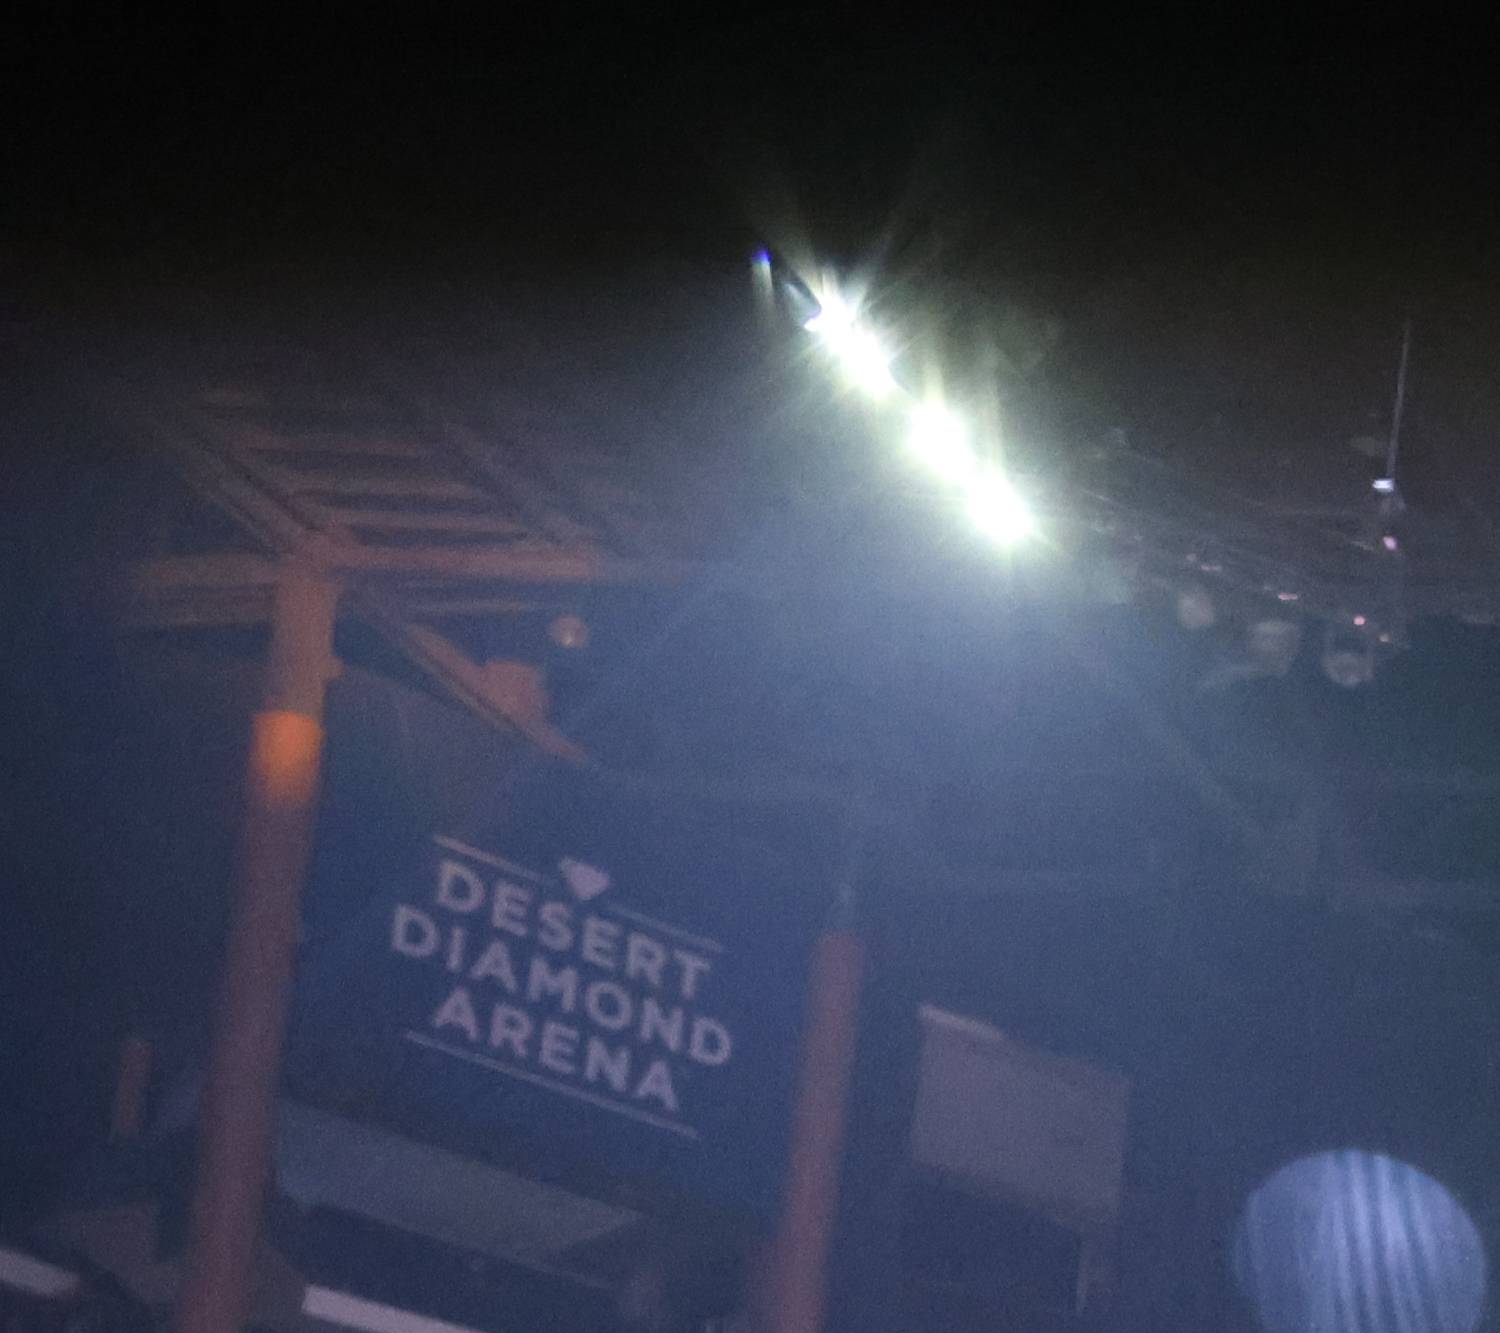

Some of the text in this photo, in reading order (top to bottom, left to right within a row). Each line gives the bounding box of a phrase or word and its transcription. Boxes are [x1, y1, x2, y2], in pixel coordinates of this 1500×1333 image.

[391, 903, 733, 1066] DIAMOND
[437, 860, 713, 1000] DESERT
[434, 985, 680, 1112] ARENA
